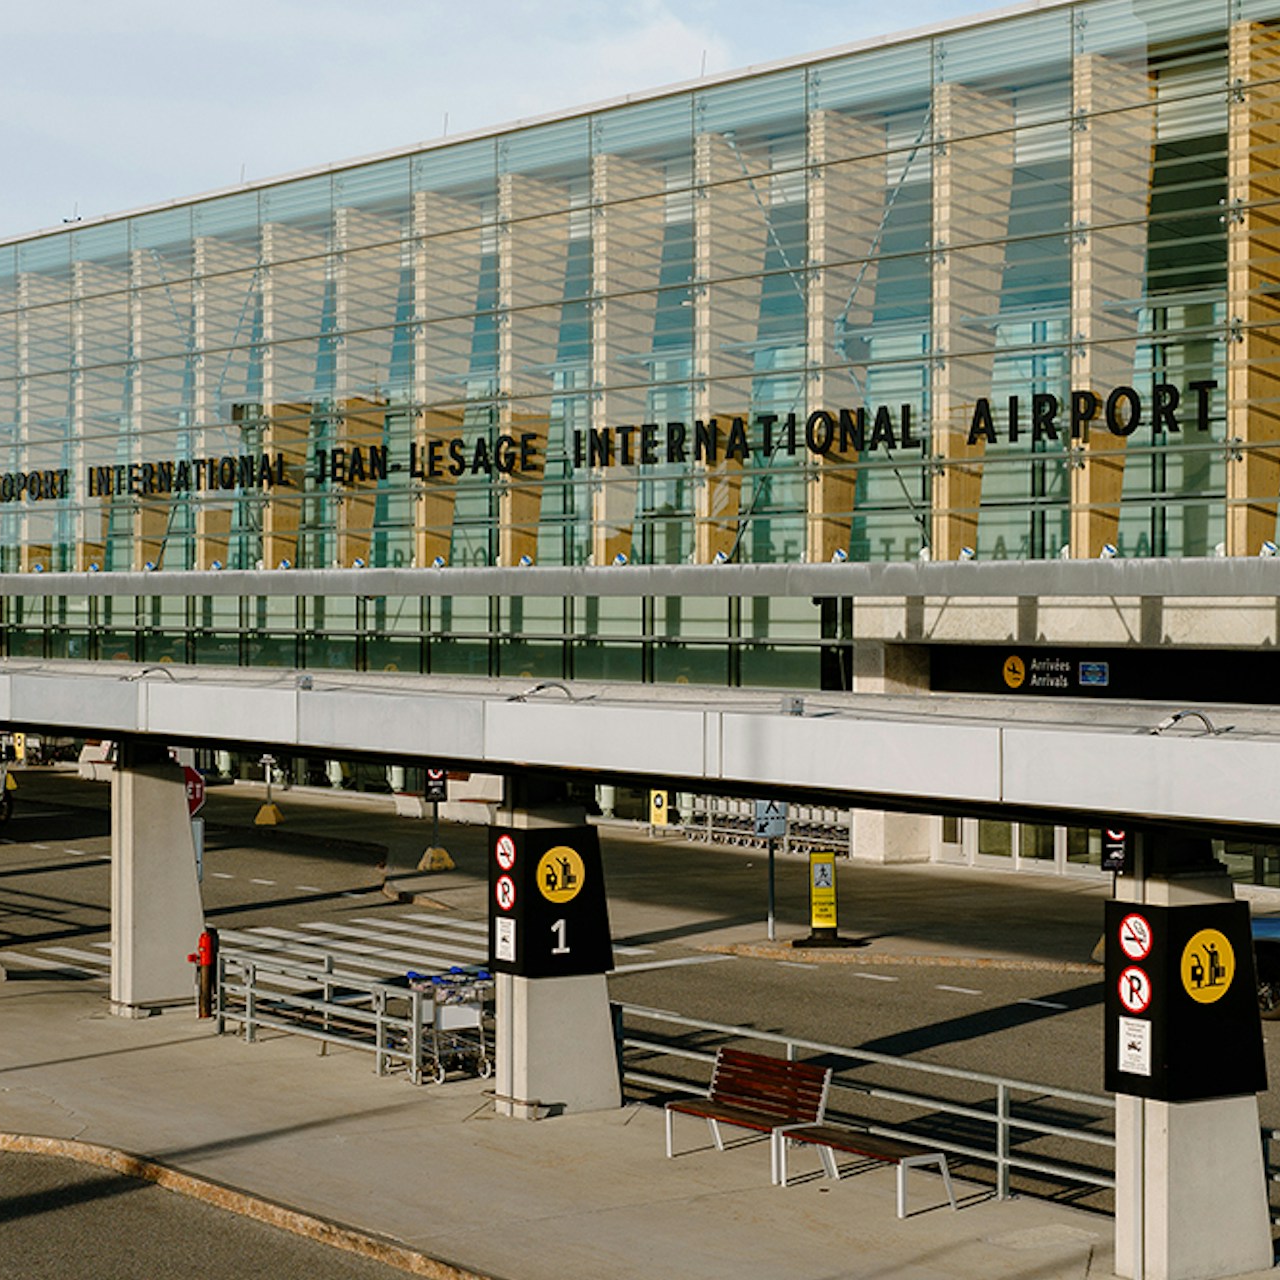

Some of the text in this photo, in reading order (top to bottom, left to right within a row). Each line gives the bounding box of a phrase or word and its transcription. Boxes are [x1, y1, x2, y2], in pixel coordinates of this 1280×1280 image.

[88, 453, 291, 497] INTERNATIONAL
[315, 432, 537, 484] JEAN-LESAGE
[573, 404, 921, 468] INTERNATIONAL
[967, 380, 1218, 445] AIRPORT
[1030, 658, 1071, 671] Arrivées
[1030, 673, 1069, 687] Arrivals
[550, 918, 571, 954] 1
